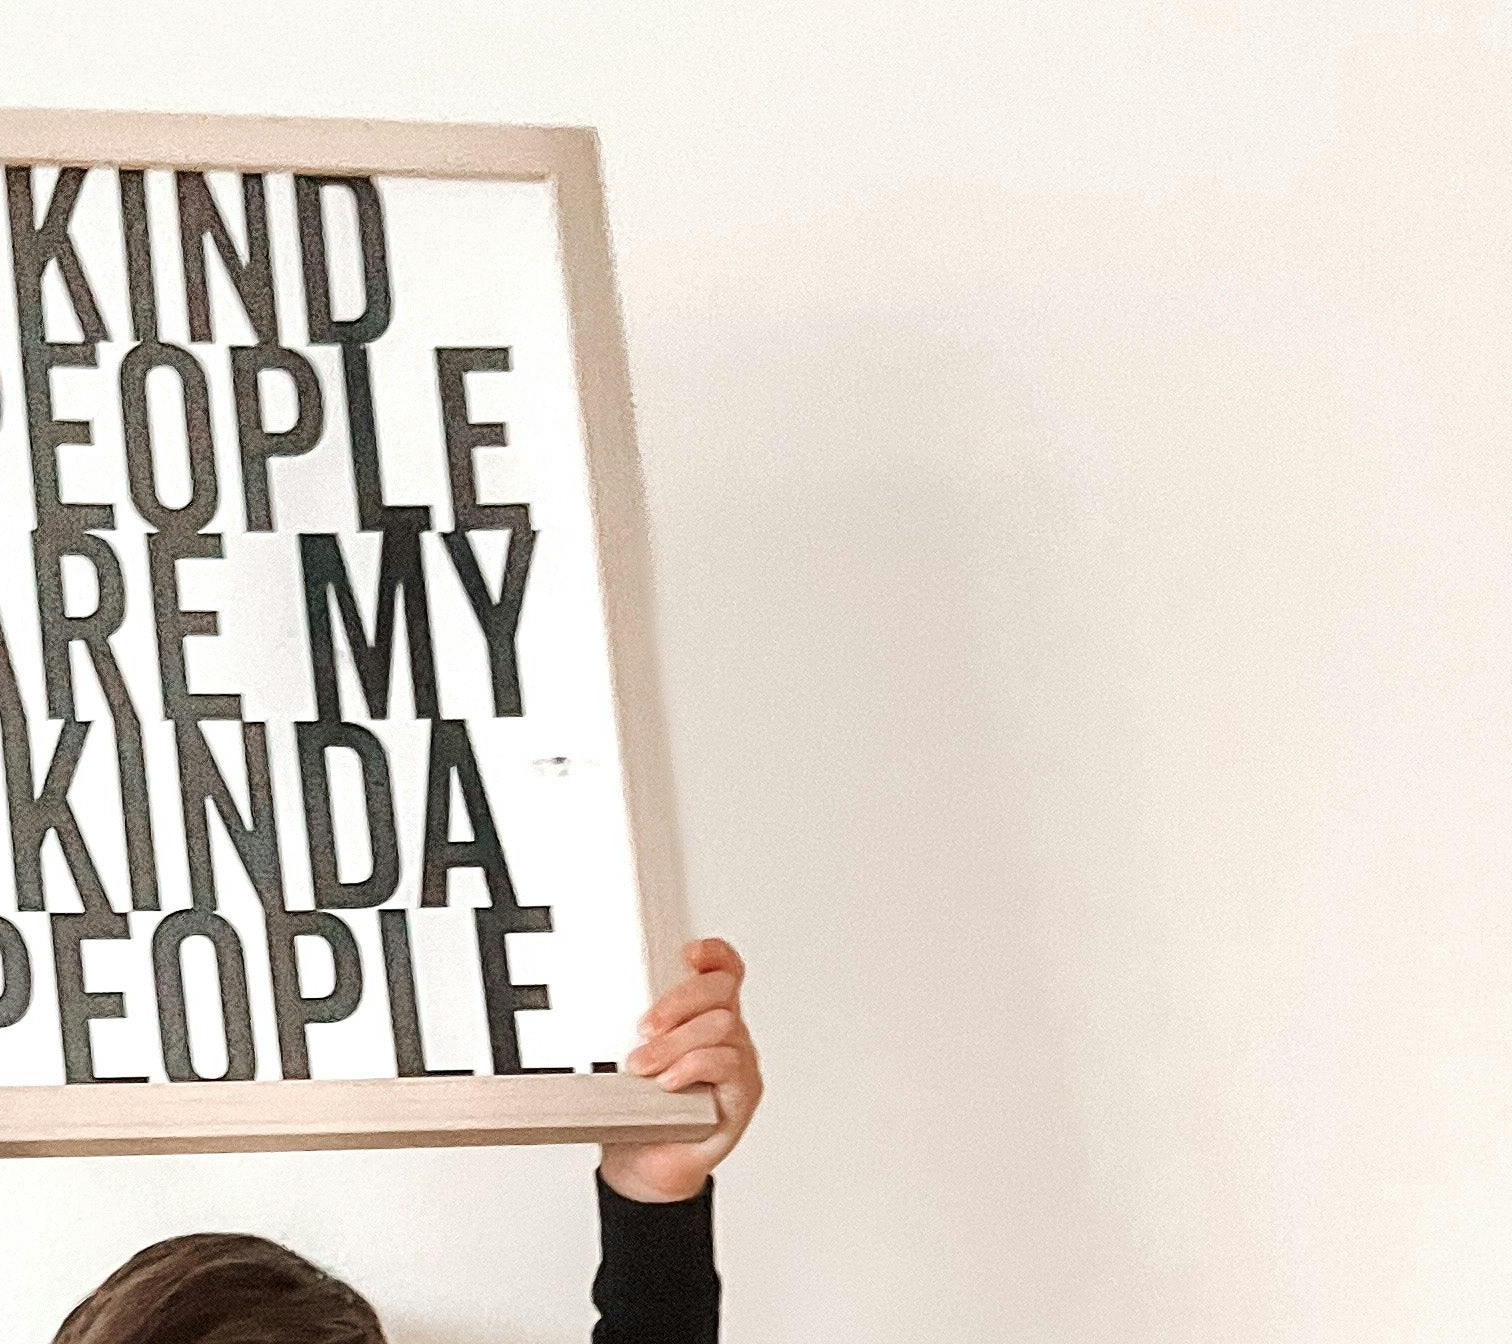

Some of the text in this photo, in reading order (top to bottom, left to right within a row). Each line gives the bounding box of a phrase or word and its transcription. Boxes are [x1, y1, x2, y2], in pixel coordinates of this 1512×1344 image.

[4, 165, 392, 345] KIND
[298, 526, 540, 720] MY
[1, 718, 517, 912] KINDA
